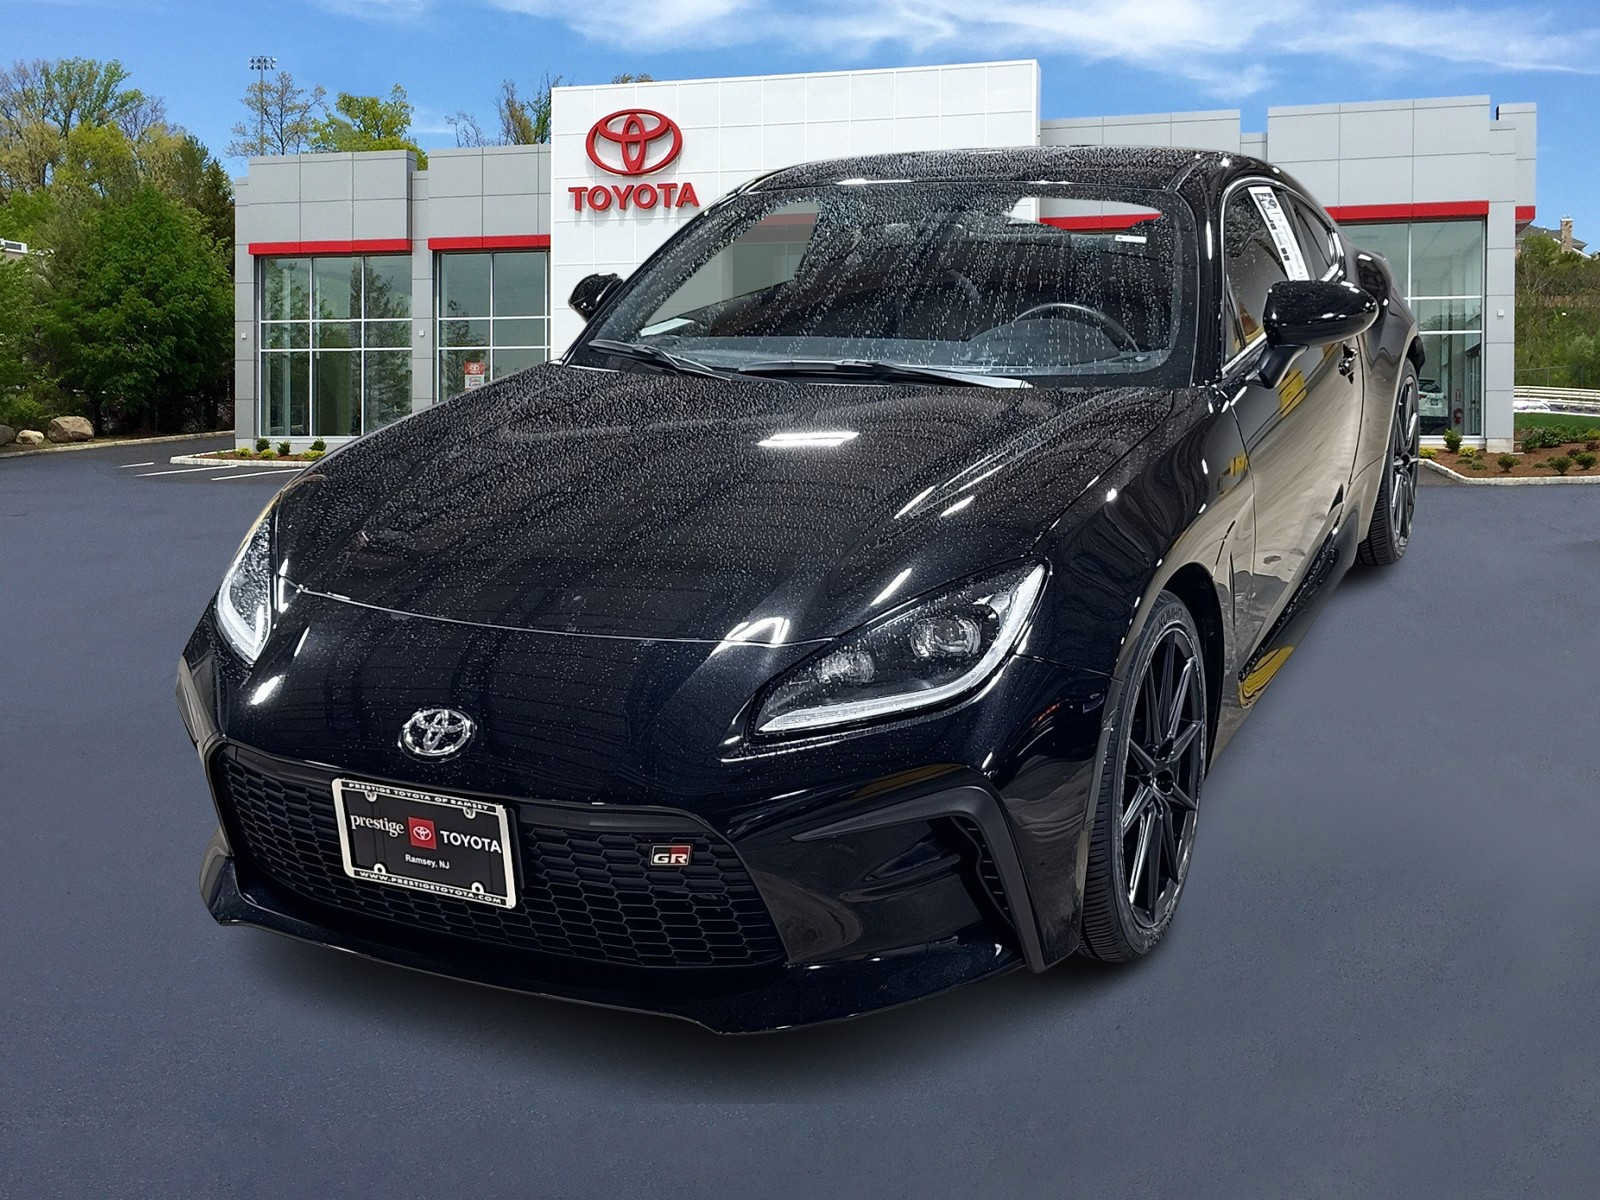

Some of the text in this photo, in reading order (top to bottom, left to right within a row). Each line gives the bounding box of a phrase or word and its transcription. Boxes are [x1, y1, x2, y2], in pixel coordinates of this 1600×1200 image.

[568, 182, 700, 212] TOYOTA
[349, 783, 391, 794] PRESTIGE
[394, 790, 431, 800] TOYOTA
[450, 799, 488, 810] RAMSEY
[350, 815, 405, 838] prestige
[440, 830, 502, 854] TOYOTA
[405, 854, 450, 870] Ramsey, NJ
[653, 853, 688, 864] GR
[359, 871, 501, 903] WWW.PRESTIGETOYOTA.COM
